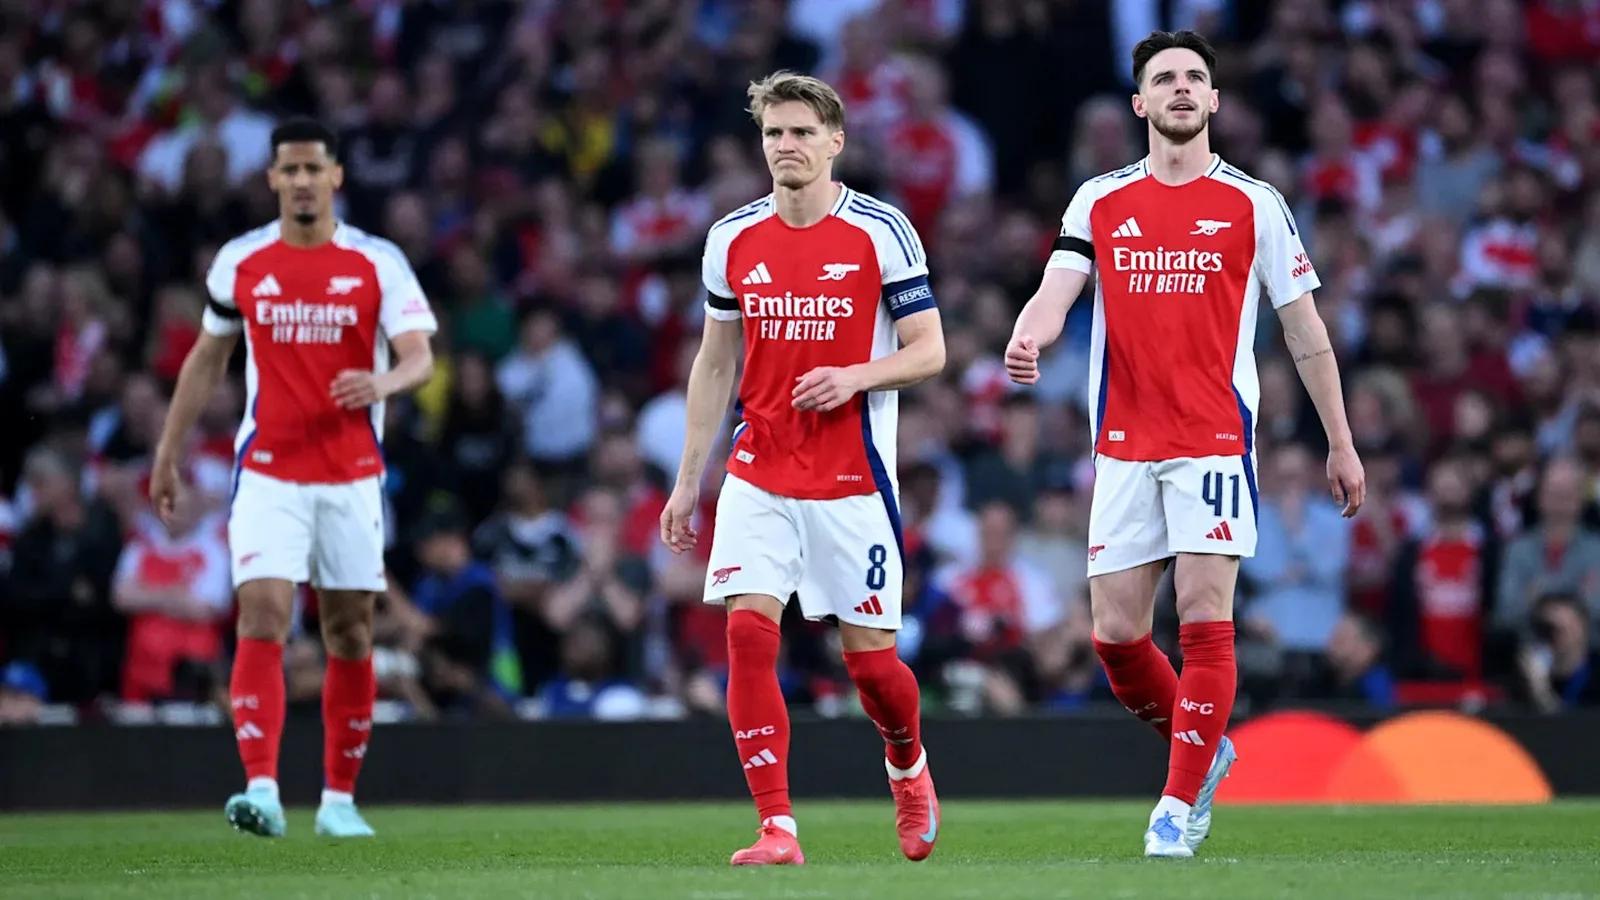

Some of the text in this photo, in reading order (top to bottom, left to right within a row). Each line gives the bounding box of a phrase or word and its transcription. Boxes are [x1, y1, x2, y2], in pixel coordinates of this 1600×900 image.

[1113, 246, 1222, 272] Emirates
[1128, 273, 1206, 294] FLY BETTER
[256, 299, 358, 326] Emirates
[743, 291, 853, 317] Emirates
[761, 320, 835, 340] FLY BETTER
[1202, 470, 1239, 518] 41
[866, 544, 887, 590] 8
[1180, 697, 1214, 715] AFC
[735, 725, 775, 739] AFC
